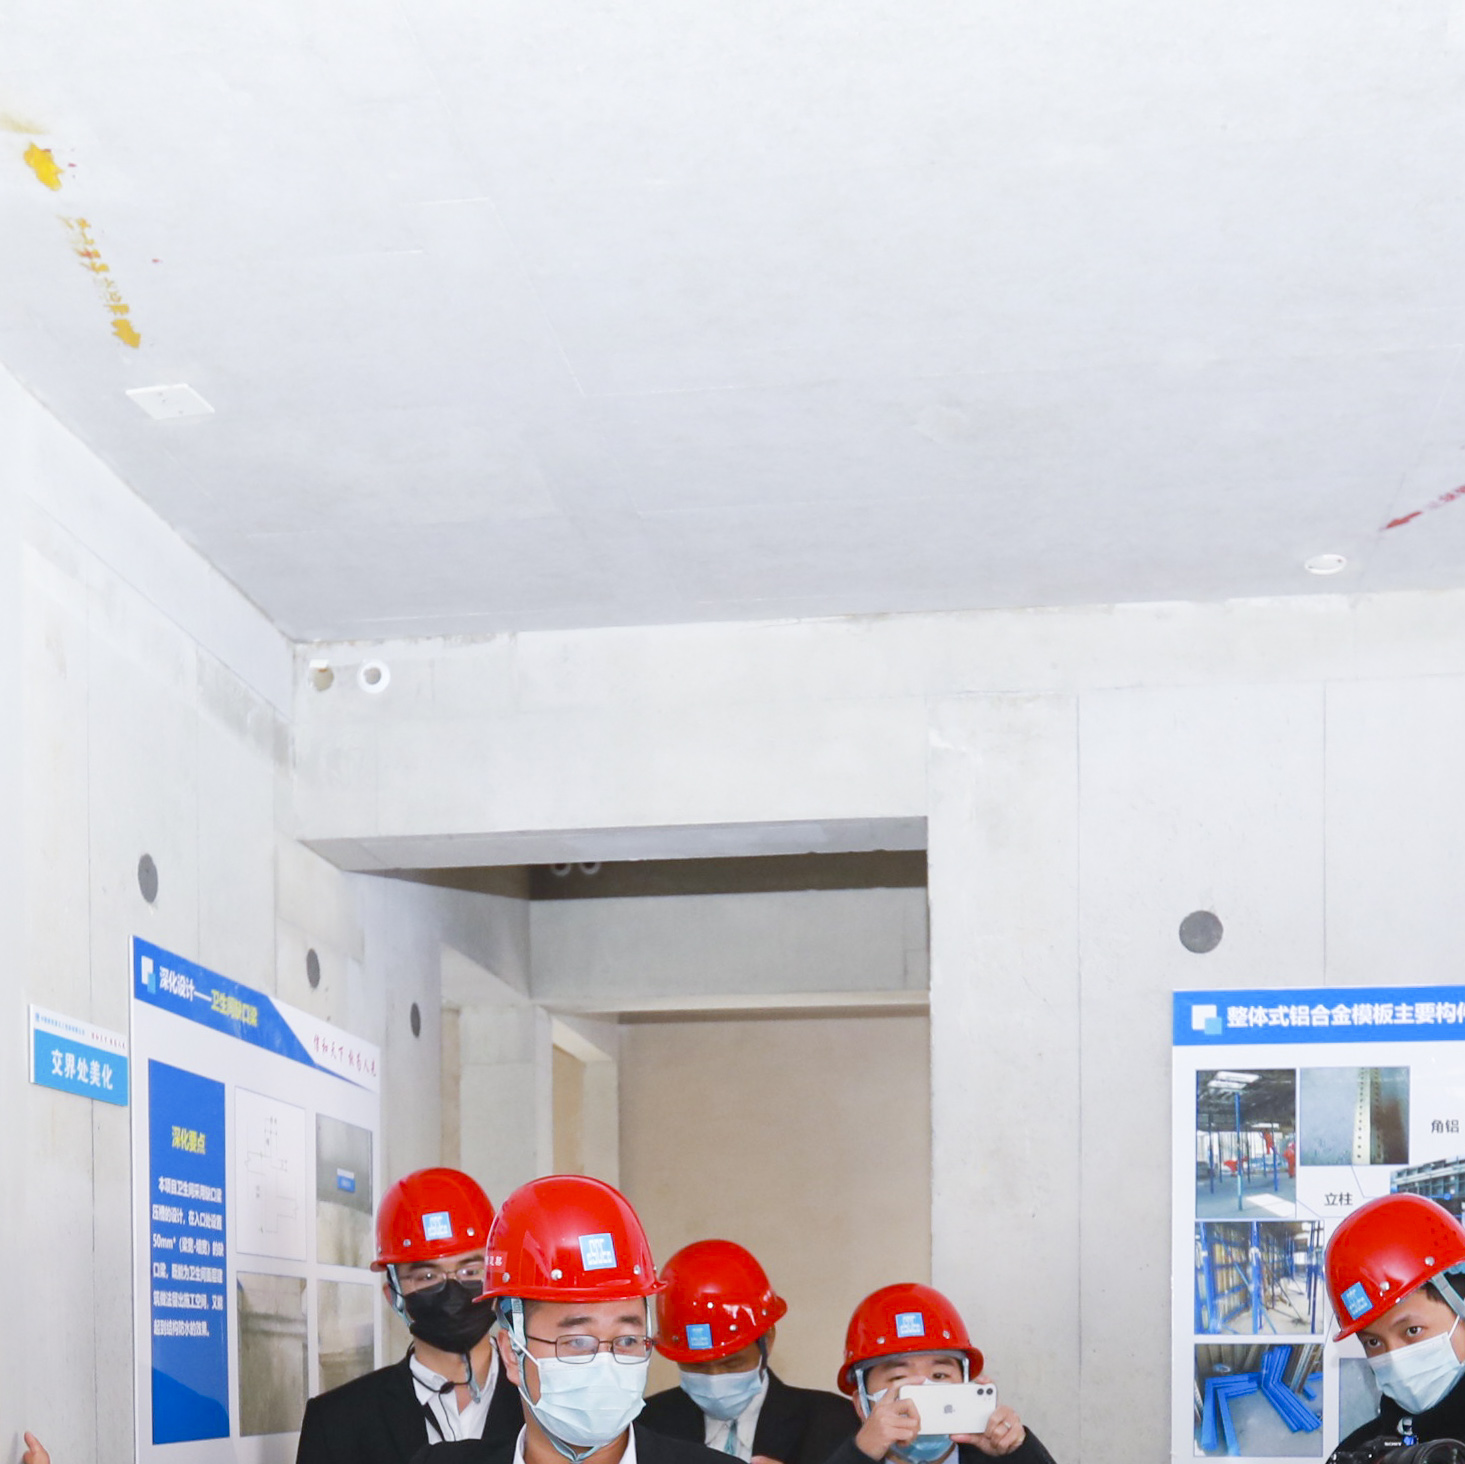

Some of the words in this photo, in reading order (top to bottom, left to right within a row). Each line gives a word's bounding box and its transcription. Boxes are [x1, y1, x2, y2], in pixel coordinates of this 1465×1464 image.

[50, 1048, 113, 1090] 交界处美化
[1431, 1119, 1459, 1134] 角铝
[171, 1125, 206, 1155] 深化要点
[1324, 1192, 1353, 1206] 立柱
